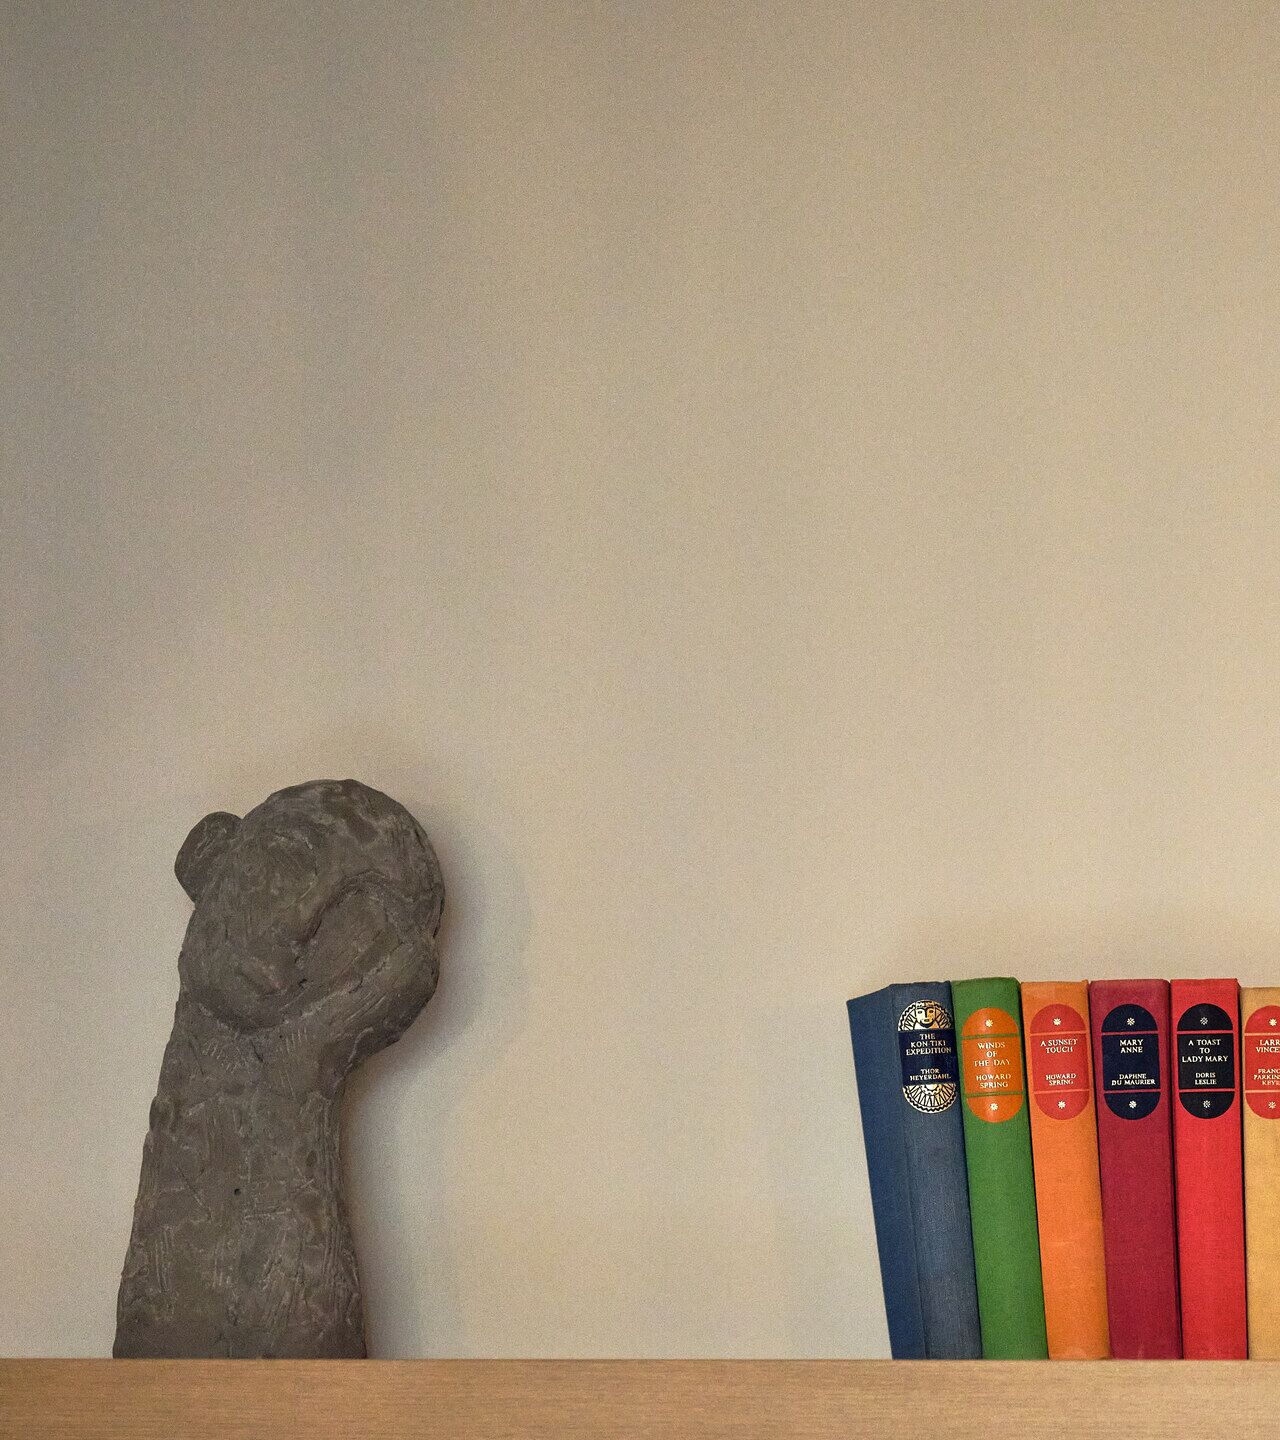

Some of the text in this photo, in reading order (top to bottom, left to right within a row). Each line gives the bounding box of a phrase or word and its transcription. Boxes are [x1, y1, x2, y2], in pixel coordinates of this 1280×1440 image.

[906, 1047, 951, 1055] EXPEDITION
[986, 1050, 998, 1058] OF
[1182, 1055, 1204, 1063] LADY
[910, 1073, 951, 1081] HEYERDAHL
